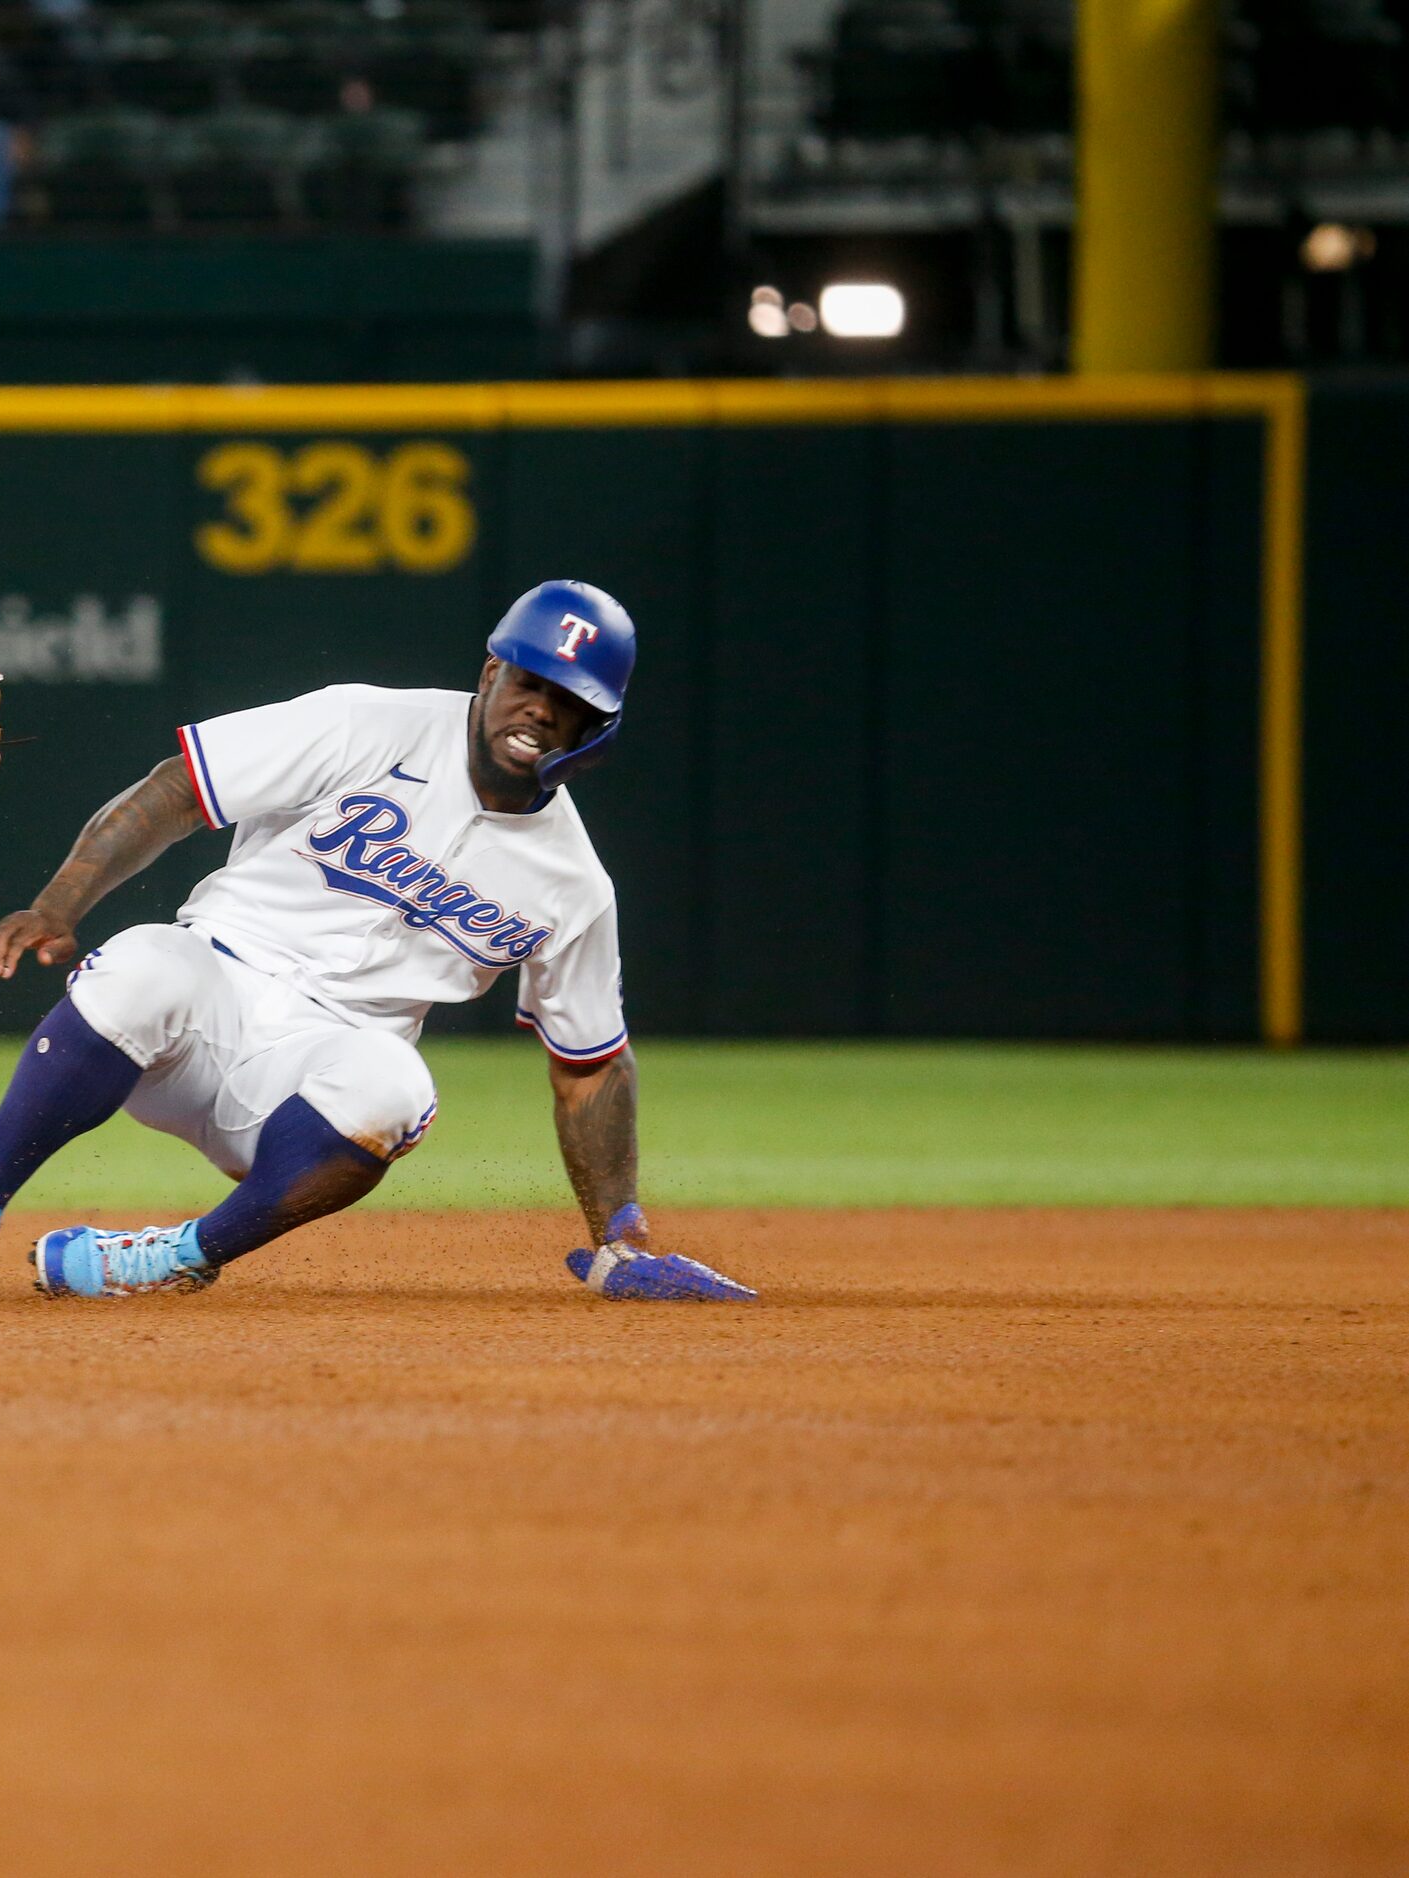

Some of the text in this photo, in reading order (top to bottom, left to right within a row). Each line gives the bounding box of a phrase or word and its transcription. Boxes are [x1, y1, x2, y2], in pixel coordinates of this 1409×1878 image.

[196, 441, 477, 573] 326
[556, 613, 599, 662] T
[294, 792, 554, 967] Rangers
